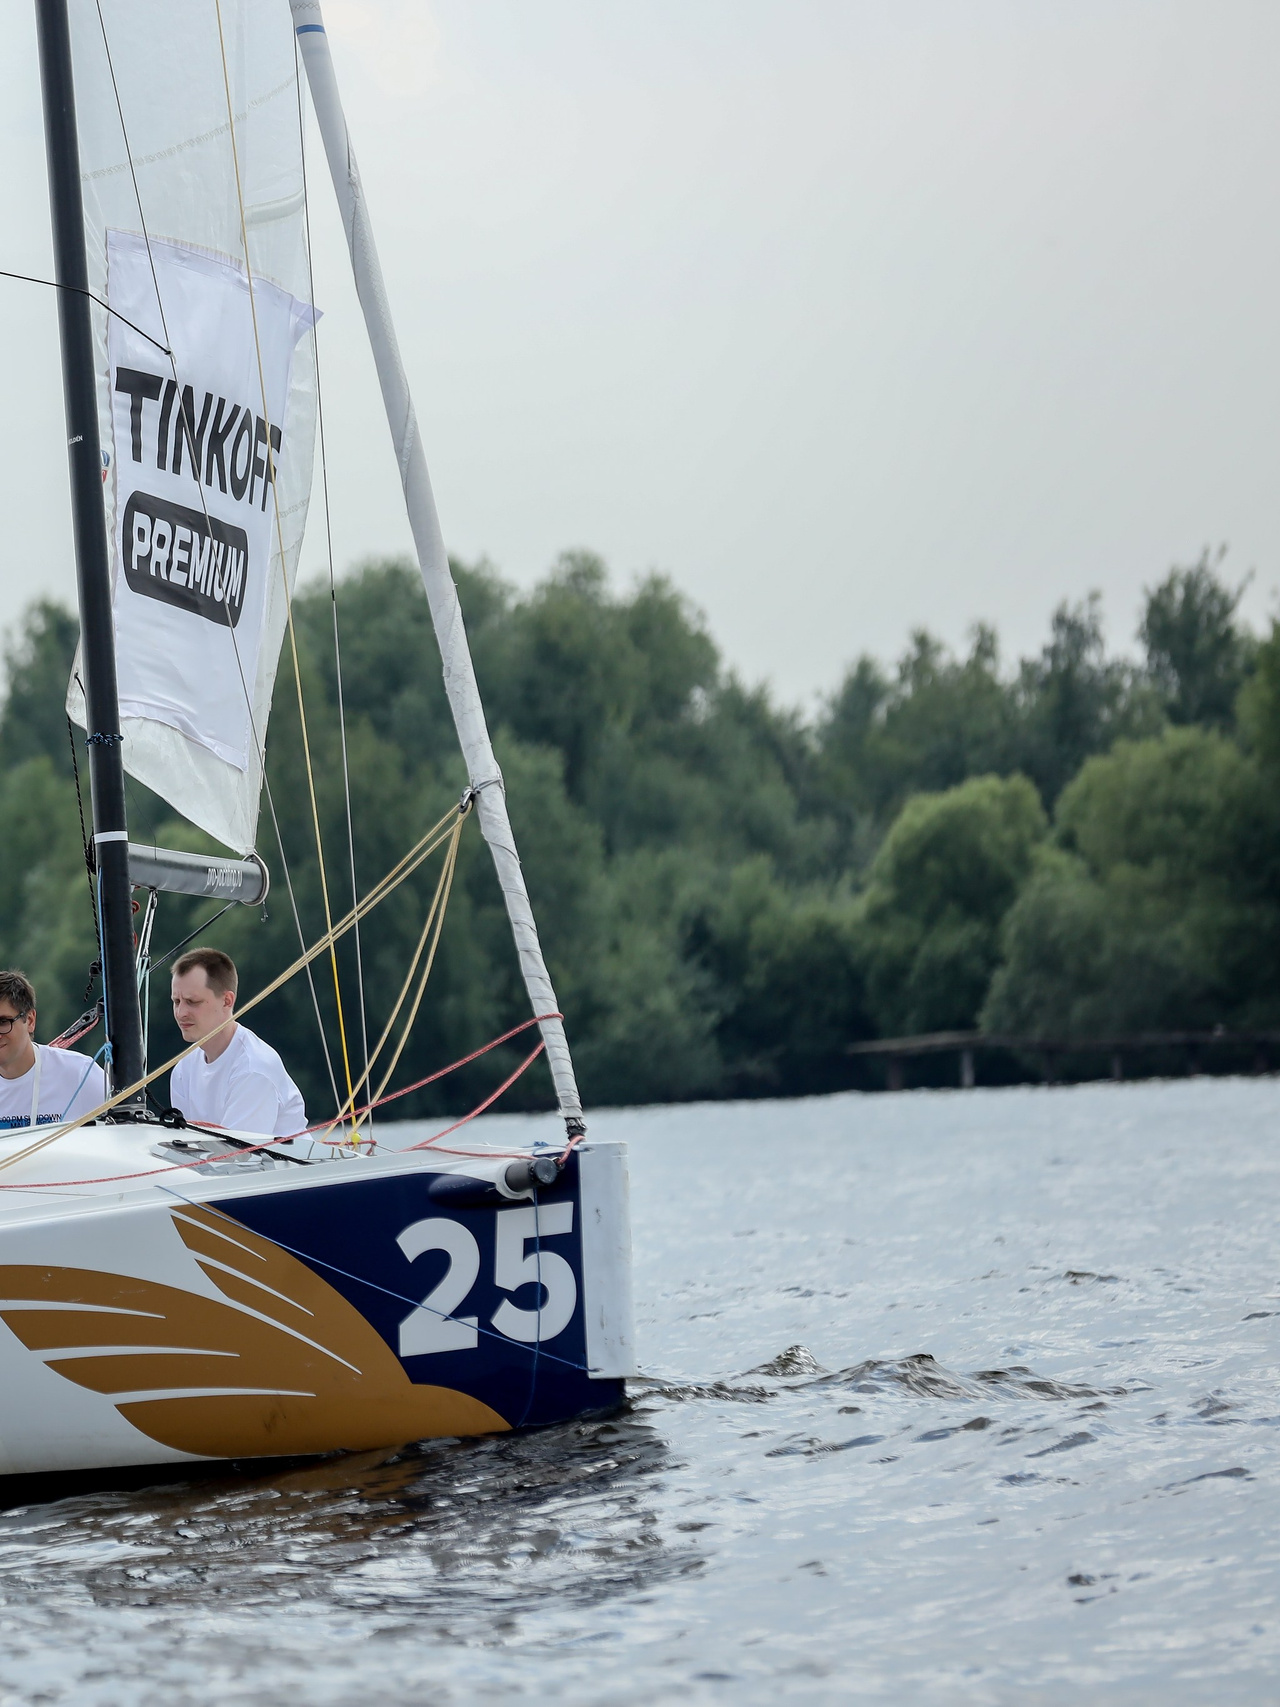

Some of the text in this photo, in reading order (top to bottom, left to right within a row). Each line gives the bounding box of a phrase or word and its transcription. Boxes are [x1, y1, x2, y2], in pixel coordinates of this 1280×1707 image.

[115, 366, 282, 512] TINKOFF
[131, 510, 244, 608] PREMIUM
[395, 1202, 577, 1357] 25
